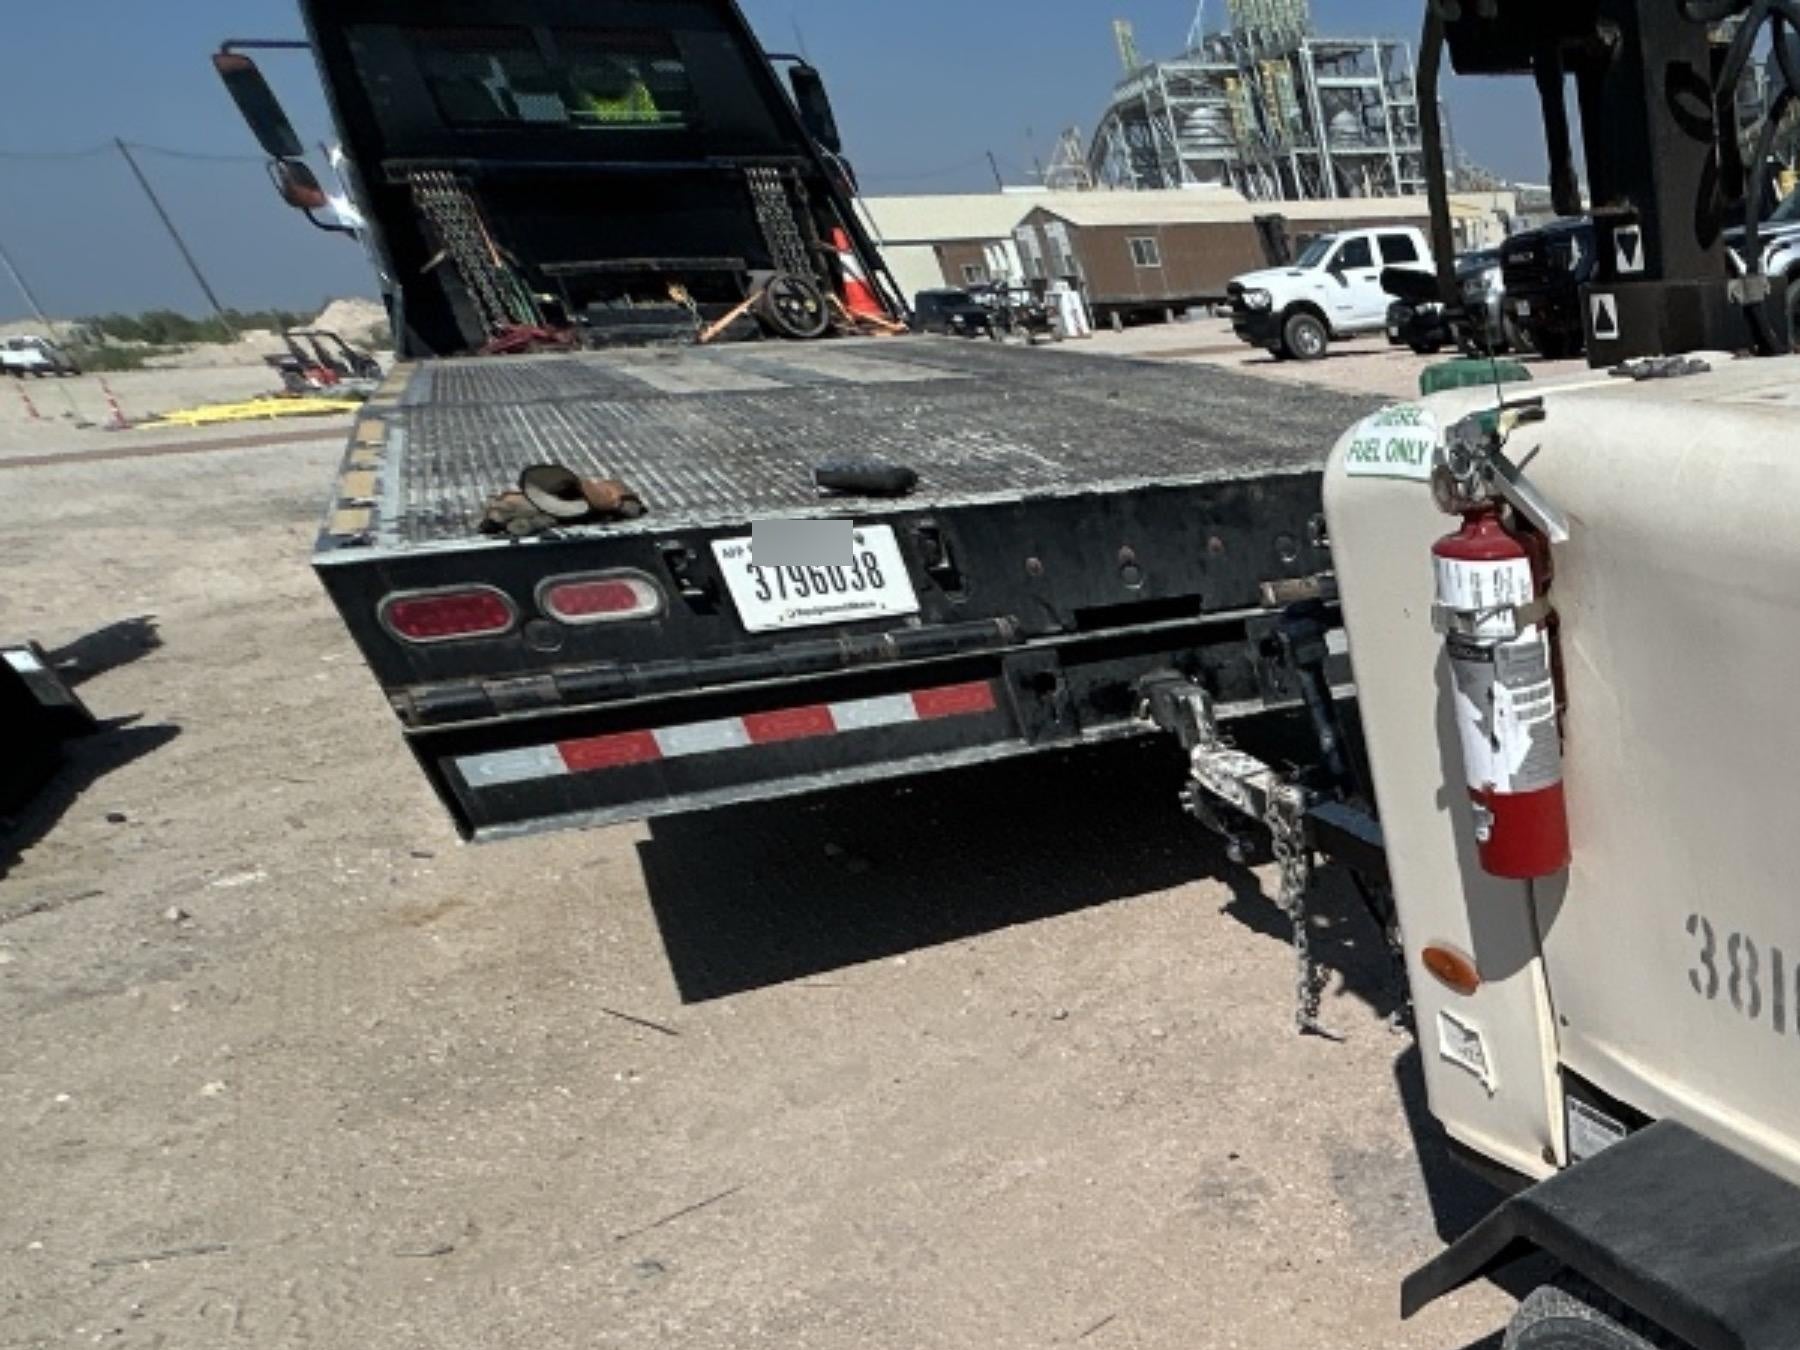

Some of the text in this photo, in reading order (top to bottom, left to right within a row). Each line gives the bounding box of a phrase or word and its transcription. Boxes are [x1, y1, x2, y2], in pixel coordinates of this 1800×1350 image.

[1346, 437, 1430, 466] FUEL ONLY
[746, 550, 886, 601] 3796038
